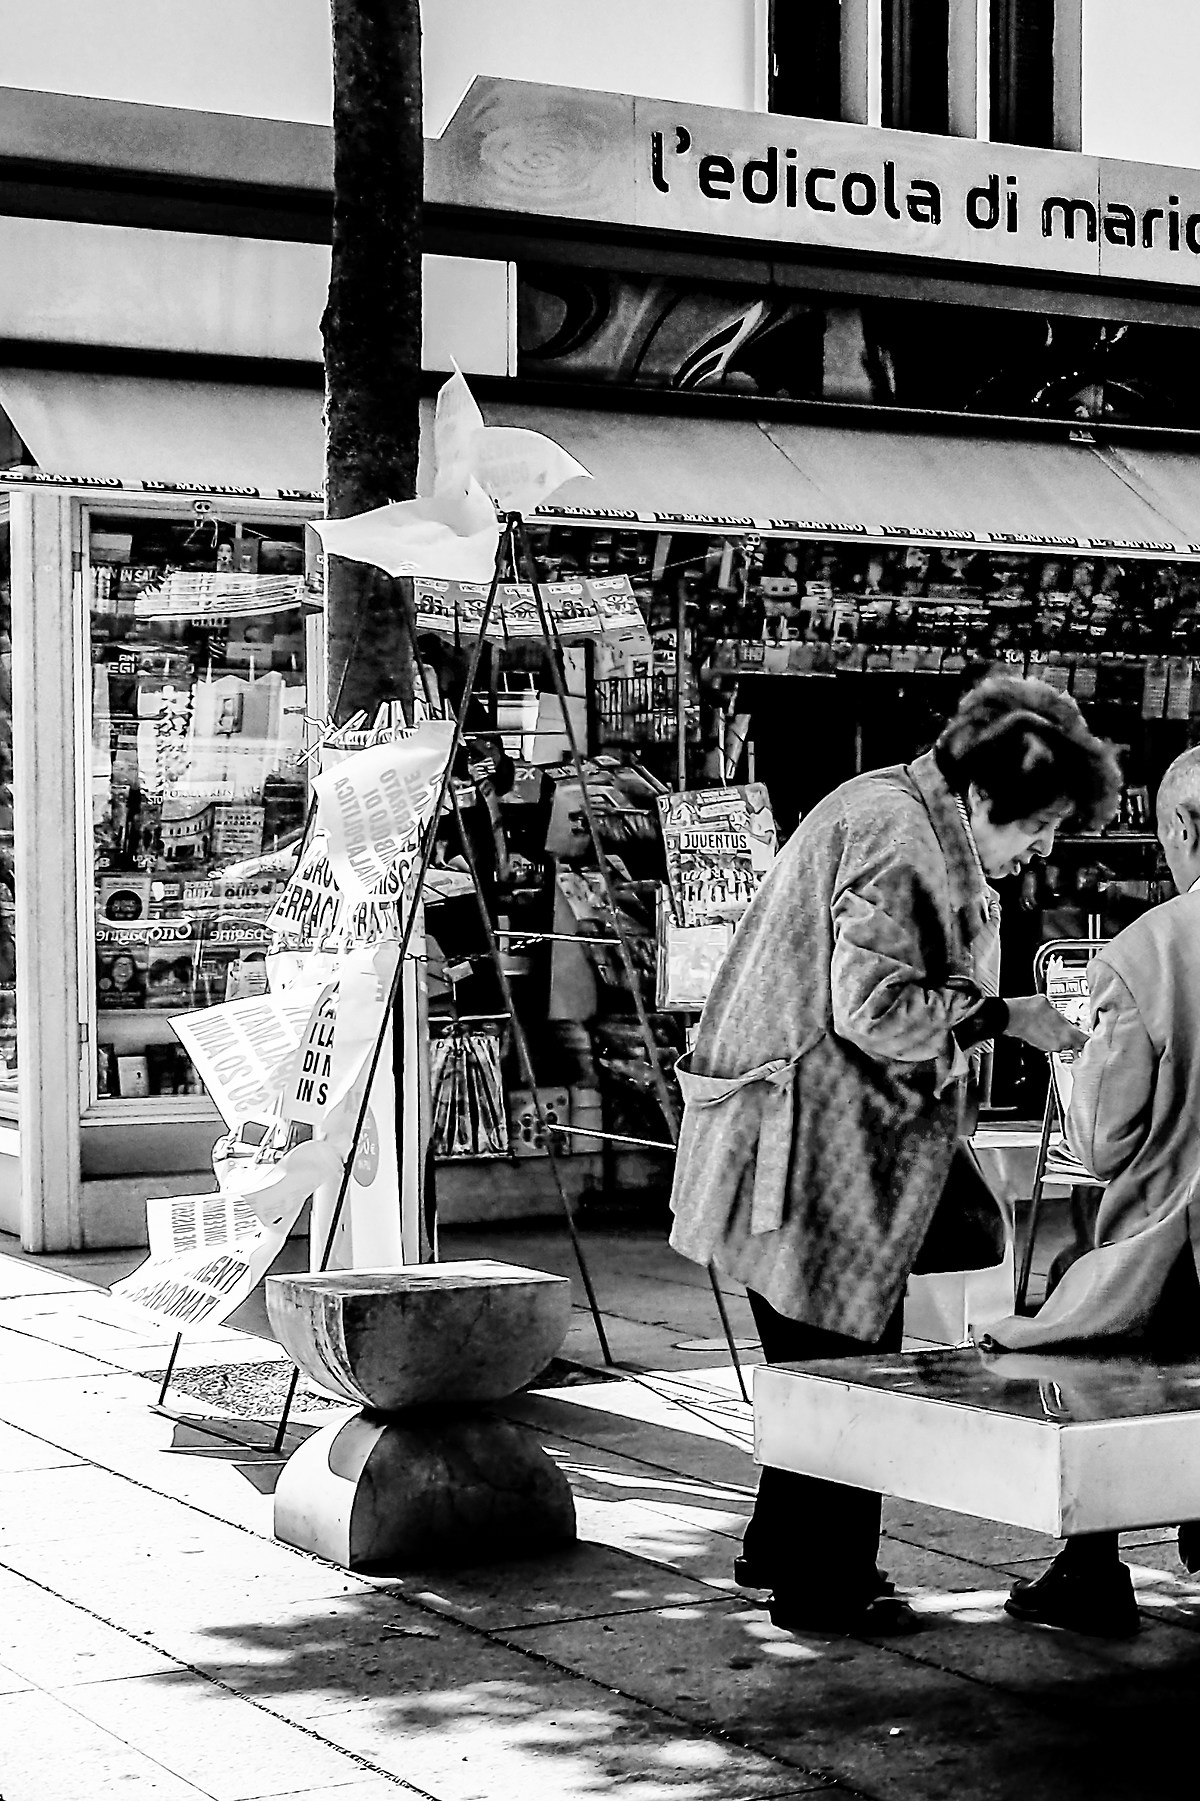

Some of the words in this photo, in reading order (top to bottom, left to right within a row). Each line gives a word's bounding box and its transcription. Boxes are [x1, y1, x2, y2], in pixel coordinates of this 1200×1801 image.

[650, 125, 941, 226] l'edicola
[965, 172, 1020, 234] di
[174, 481, 257, 495] MATTINO
[564, 505, 637, 518] MATTINO
[683, 512, 753, 525] MATTINO
[797, 520, 864, 532] MATTINO
[908, 526, 974, 539] MATTINO
[684, 833, 748, 849] JUVENTUS
